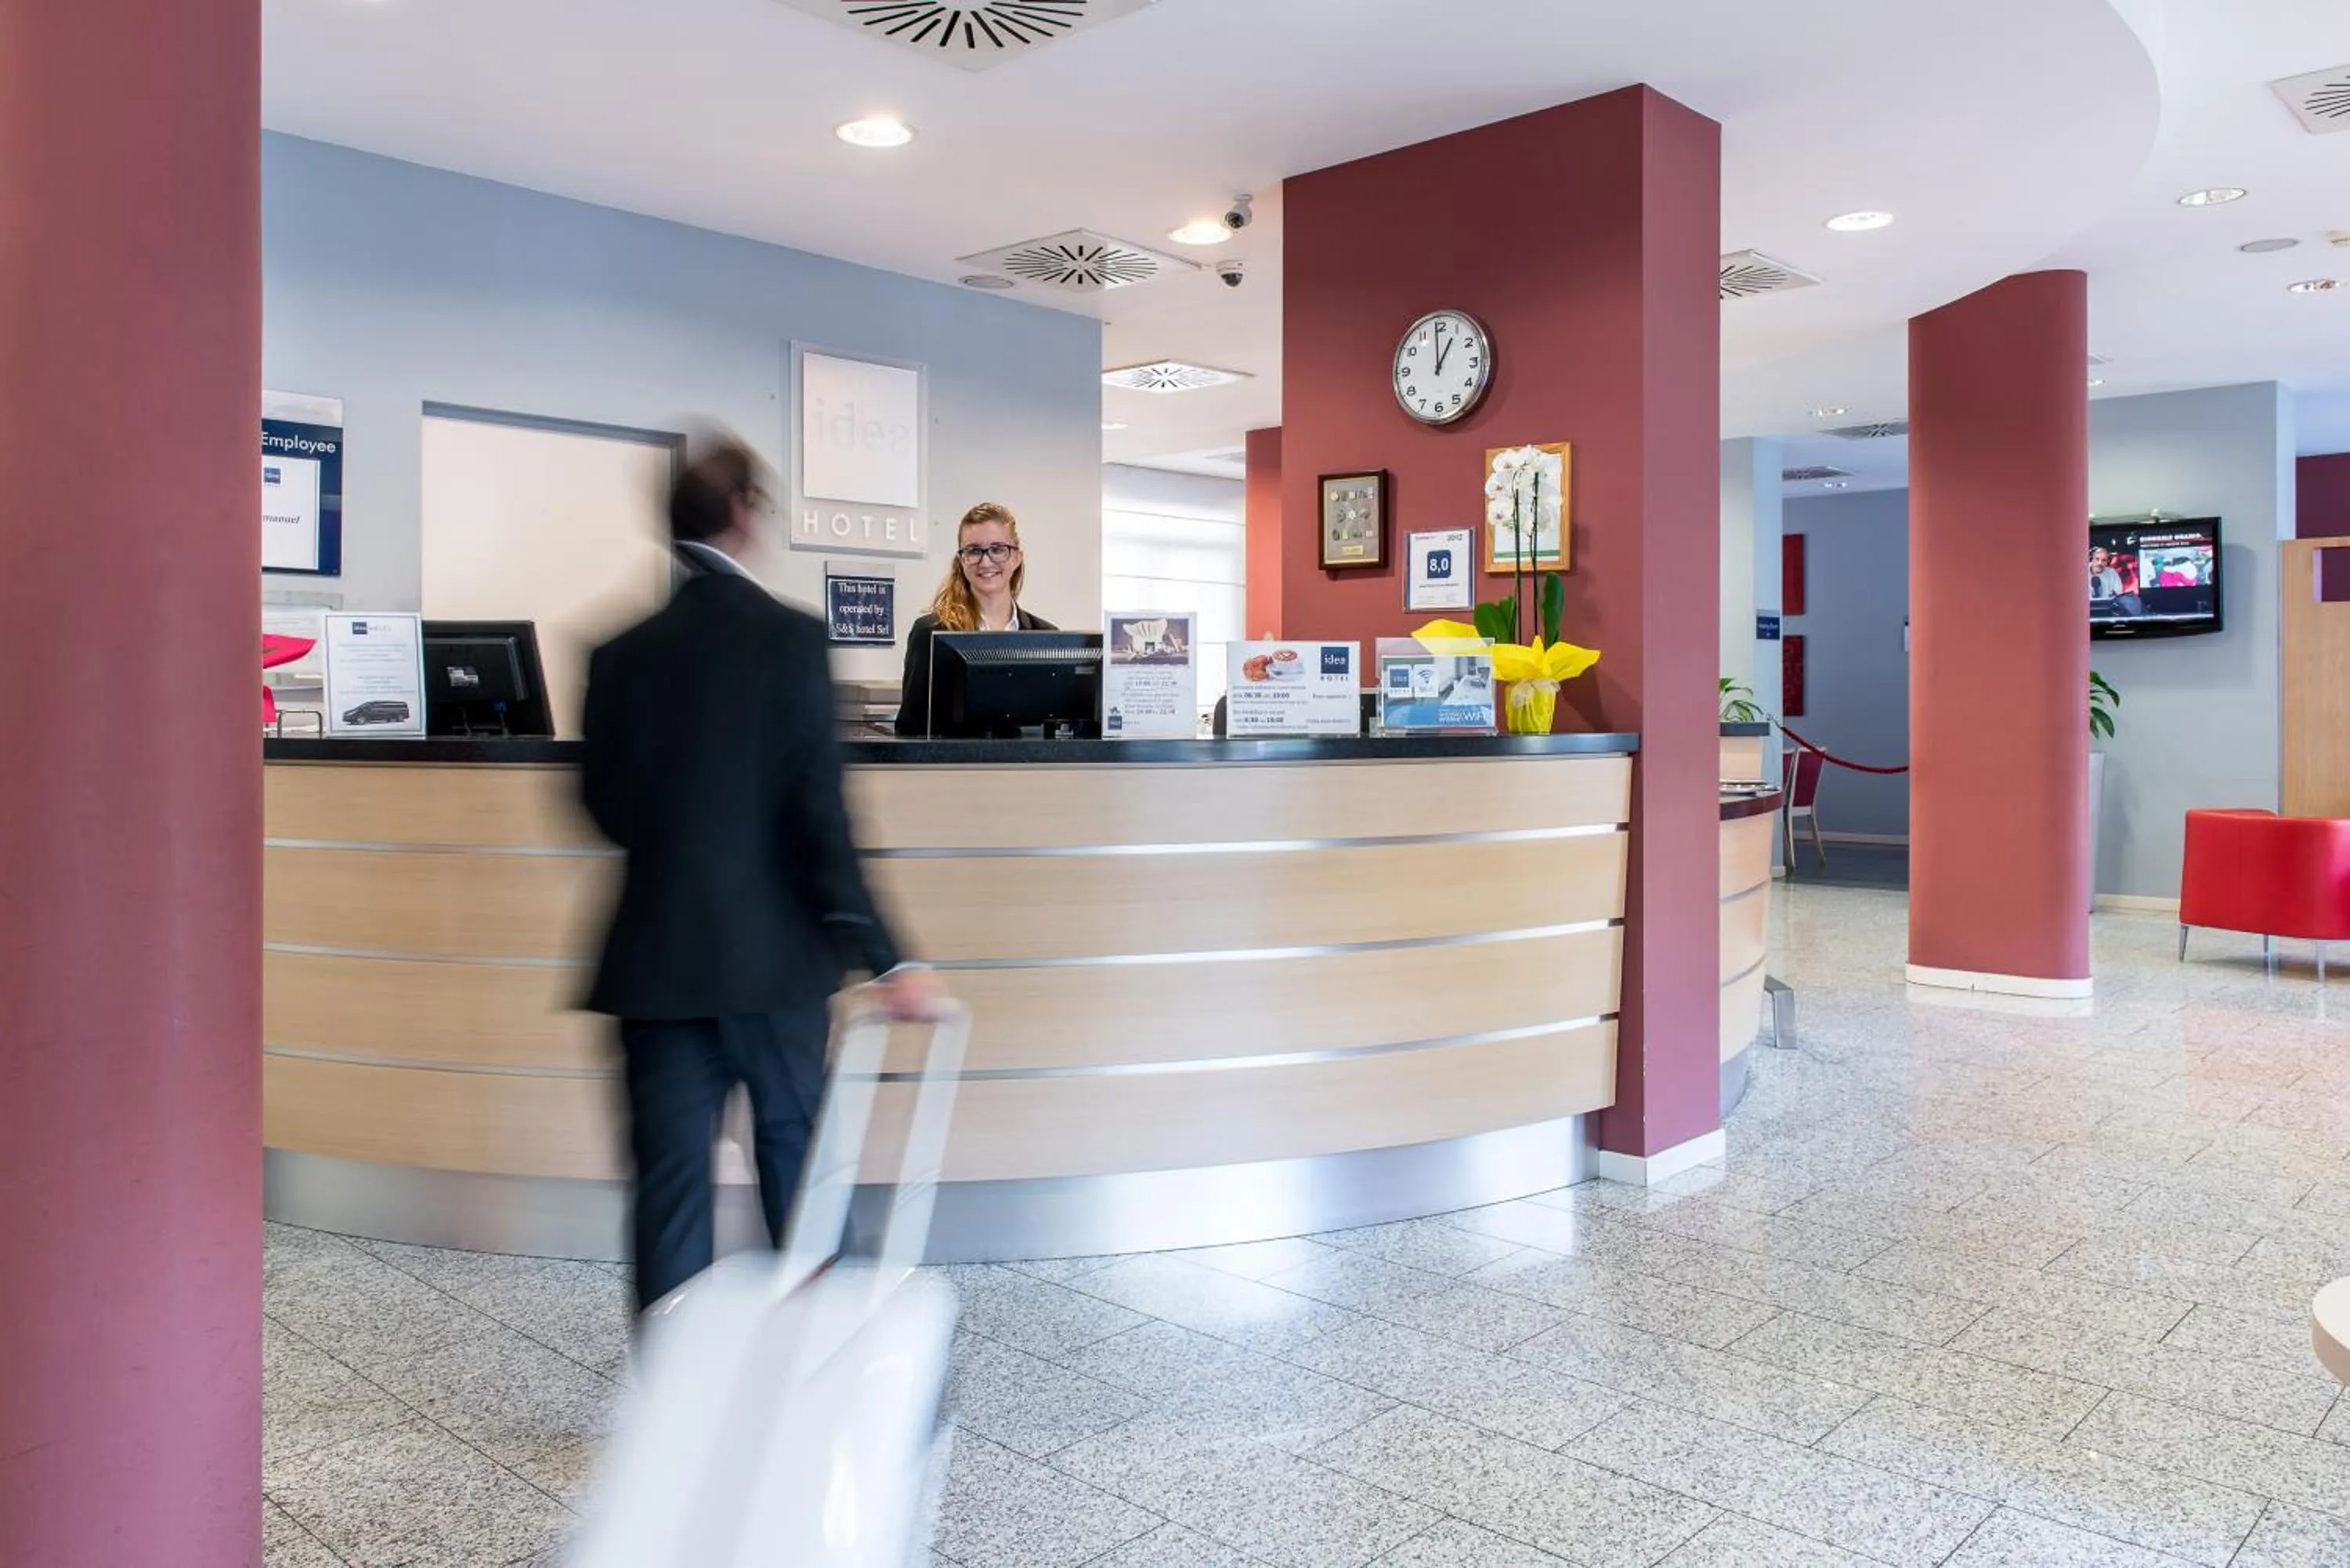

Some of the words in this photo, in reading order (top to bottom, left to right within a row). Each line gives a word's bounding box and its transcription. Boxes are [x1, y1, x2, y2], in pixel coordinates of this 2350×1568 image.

[1434, 322, 1448, 333] 2
[1419, 330, 1426, 342] 11
[1464, 338, 1473, 349] 2
[1407, 346, 1417, 357] 10
[1469, 356, 1478, 368] 3
[1401, 367, 1410, 378] 9
[1464, 377, 1473, 387] 4
[1406, 385, 1416, 396] 8
[1419, 399, 1426, 410] 7
[1452, 394, 1461, 405] 5
[1434, 402, 1444, 413] 6
[812, 396, 911, 458] idea
[262, 432, 336, 453] Employee
[803, 511, 917, 542] HOTEL
[1430, 558, 1449, 574] 8,0
[837, 582, 856, 593] This
[839, 605, 873, 614] operated
[874, 604, 884, 616] by
[1324, 654, 1347, 665] idea
